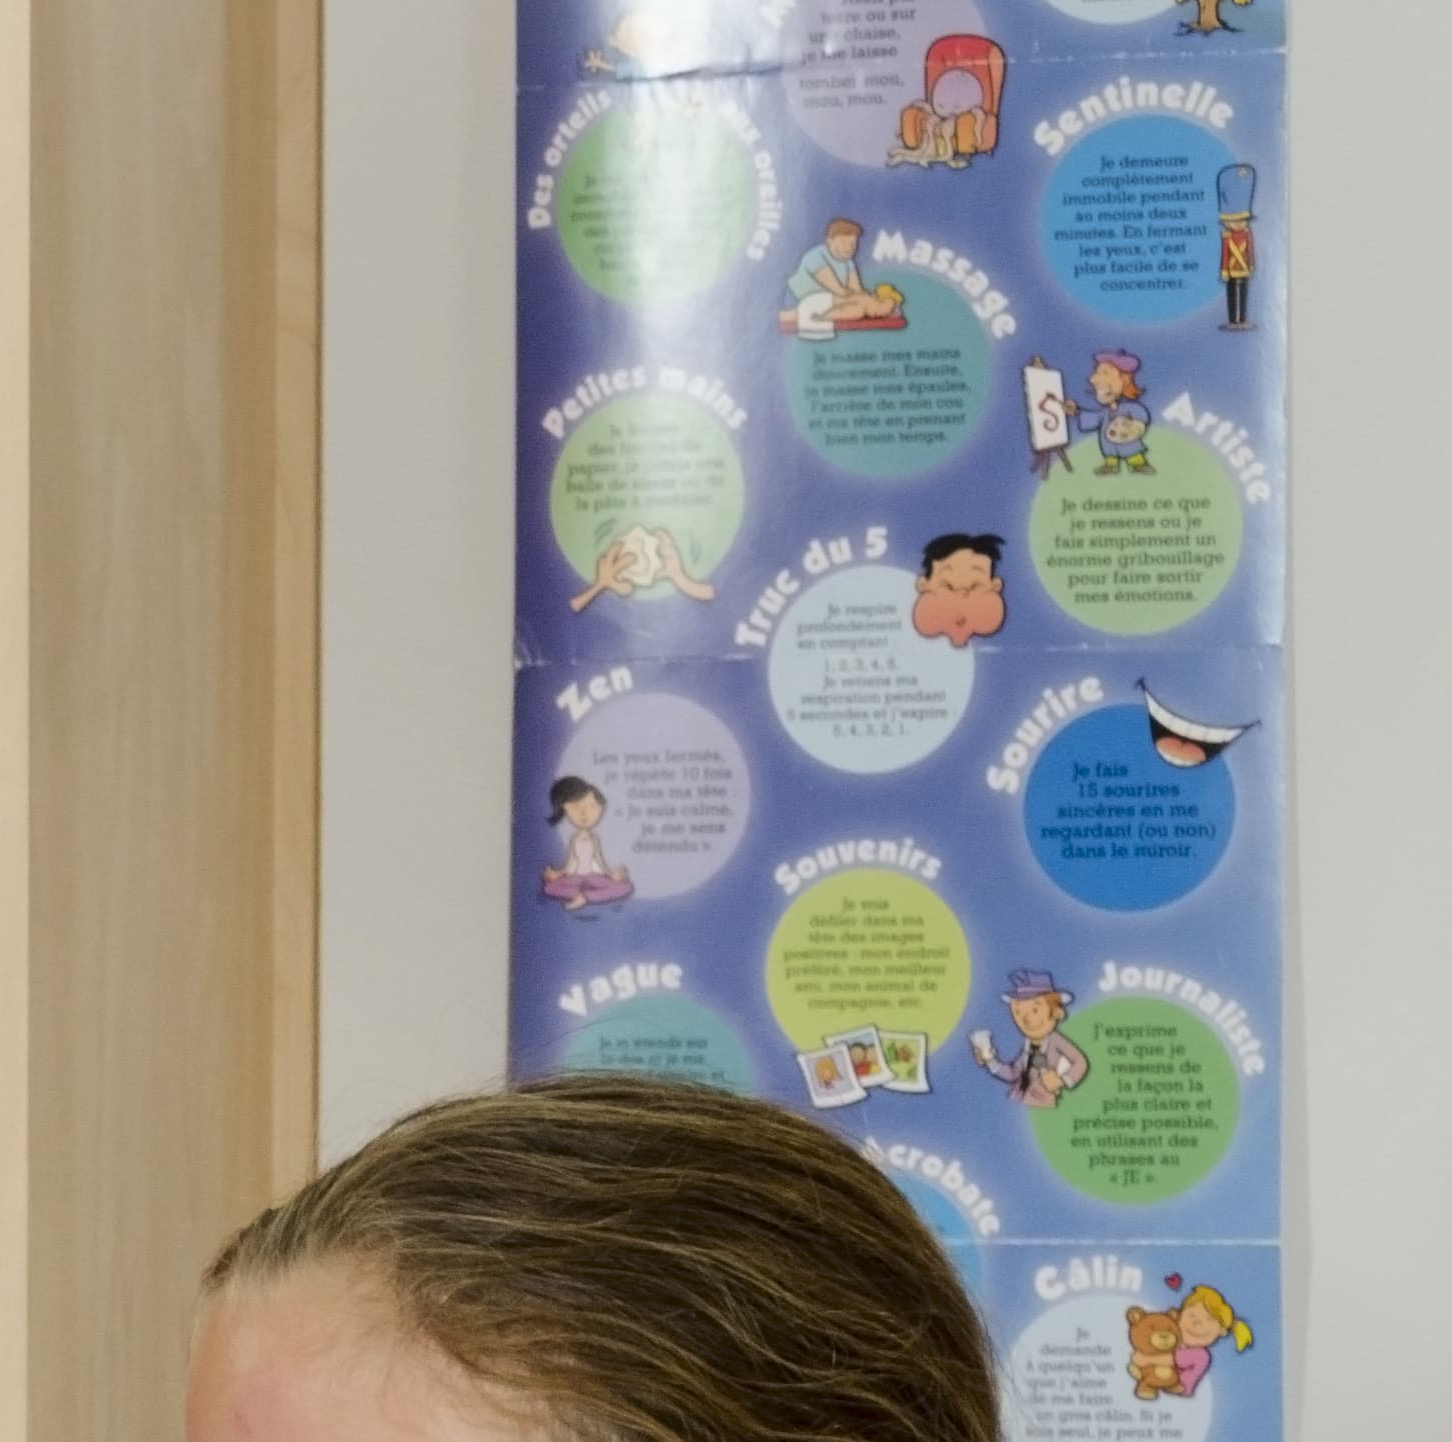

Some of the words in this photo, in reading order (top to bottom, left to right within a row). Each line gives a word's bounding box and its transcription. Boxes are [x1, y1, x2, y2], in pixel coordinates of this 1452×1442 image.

[1034, 75, 1236, 156] Sentinelle
[871, 229, 1017, 339] Massage
[658, 366, 748, 430] mains
[1160, 391, 1271, 504] Artiste
[734, 569, 801, 648] Truc
[802, 535, 853, 575] du
[865, 525, 888, 559] 5
[556, 665, 634, 723] Zen
[986, 675, 1105, 796] Sourire
[773, 837, 943, 896] Souvenirs
[557, 961, 684, 1017] Vague
[1098, 960, 1267, 1077] Journaliste
[1034, 1255, 1143, 1301] Câlin
